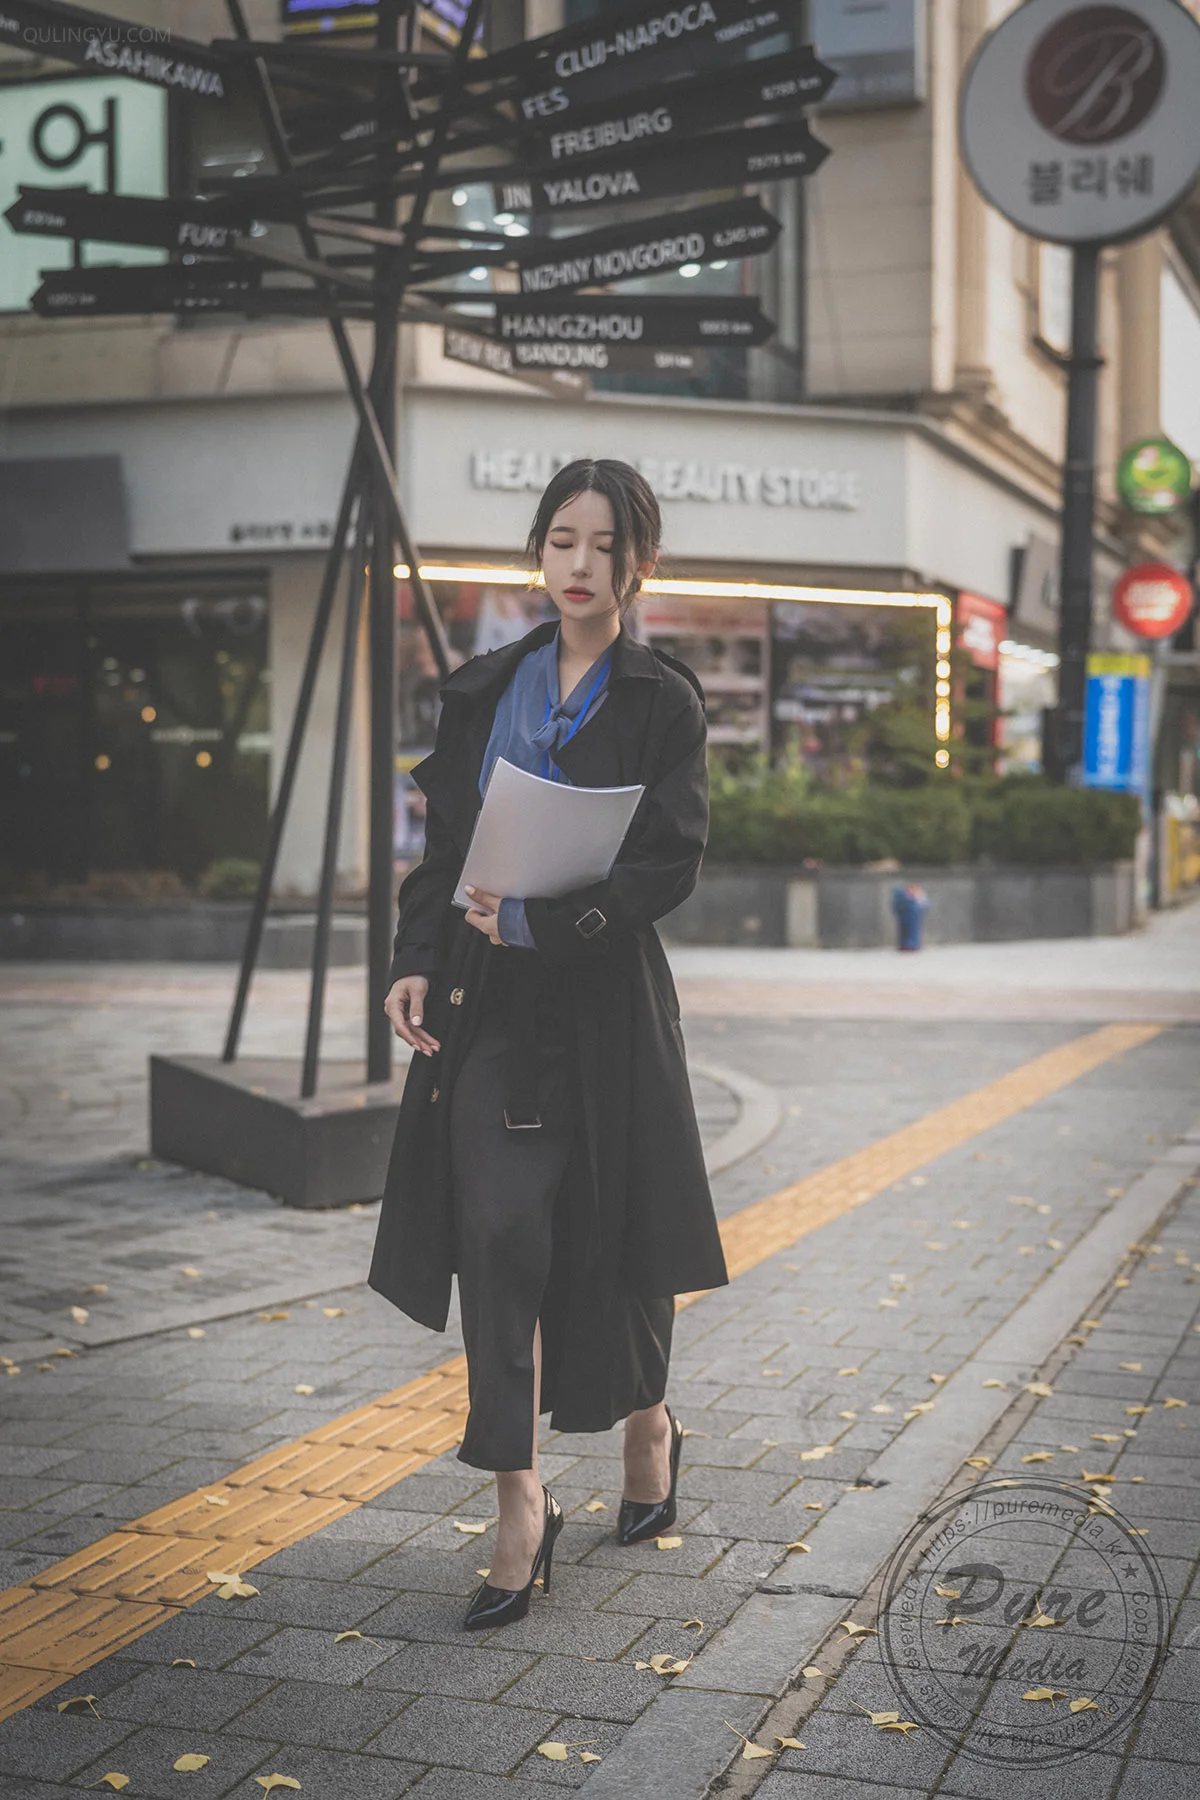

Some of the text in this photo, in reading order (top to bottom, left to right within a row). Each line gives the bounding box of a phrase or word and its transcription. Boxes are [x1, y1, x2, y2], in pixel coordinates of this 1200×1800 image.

[85, 39, 225, 98] ASAHIKAWA
[522, 86, 570, 120] FES
[550, 108, 673, 158] FREIBURG
[543, 171, 640, 206] YALOVA
[598, 233, 705, 279] NOVGOROD
[502, 315, 643, 341] HANGZHOU
[469, 450, 573, 491] HEAL
[761, 464, 861, 511] STORE
